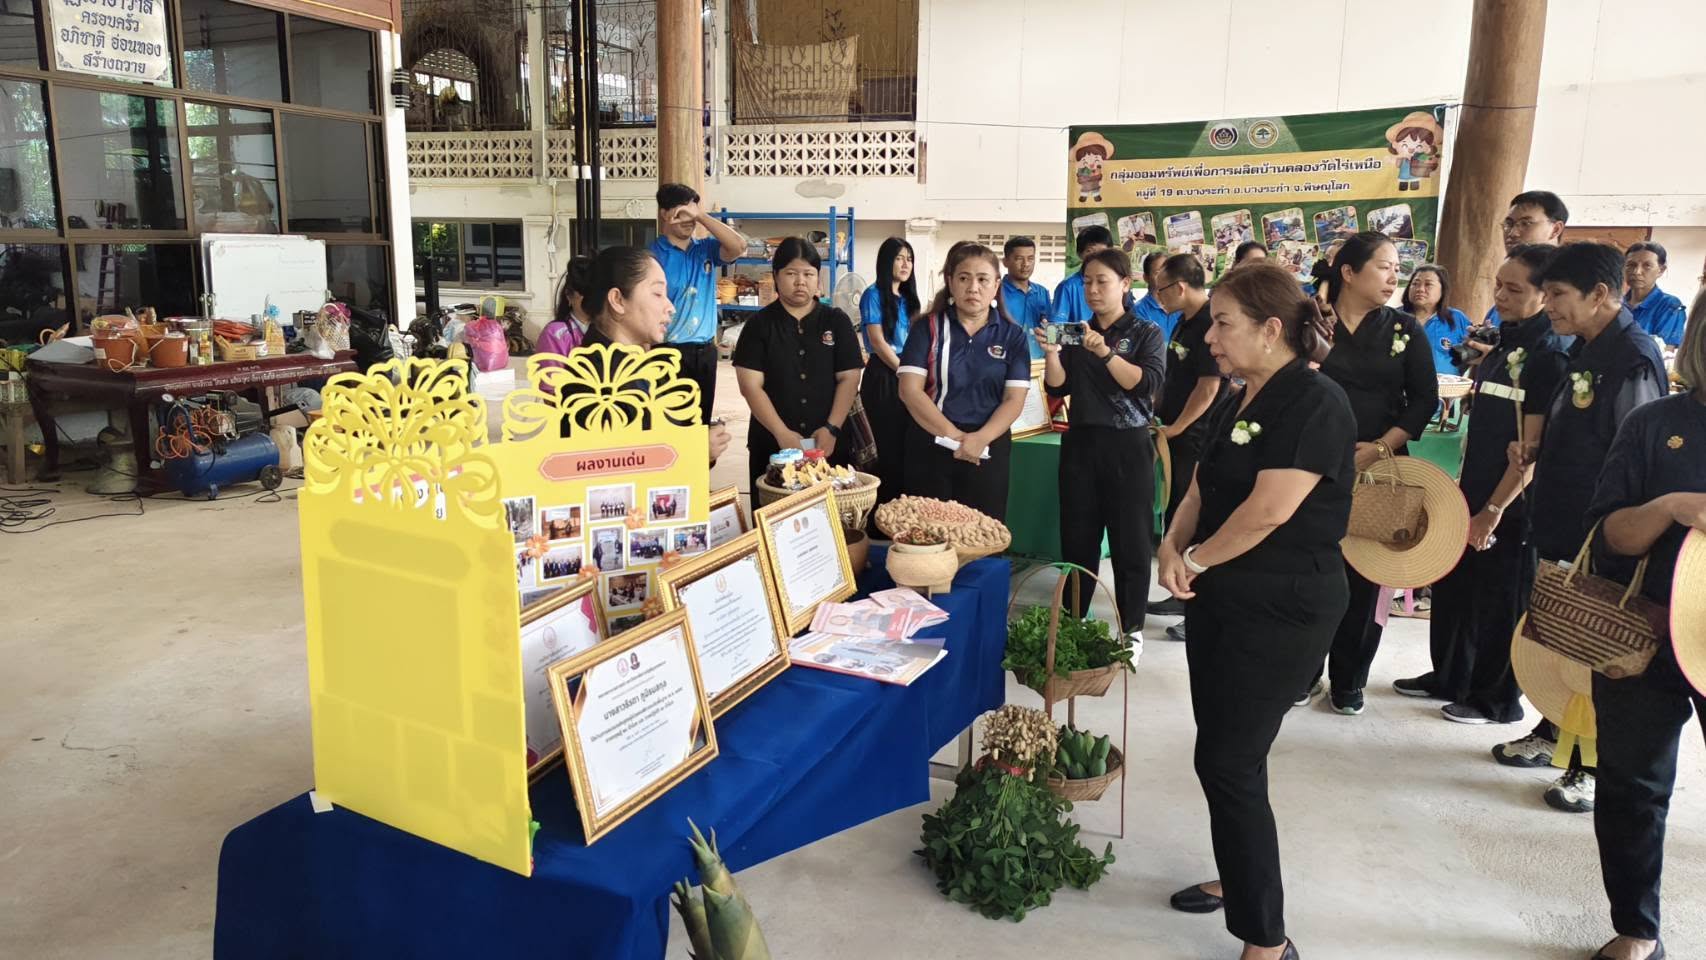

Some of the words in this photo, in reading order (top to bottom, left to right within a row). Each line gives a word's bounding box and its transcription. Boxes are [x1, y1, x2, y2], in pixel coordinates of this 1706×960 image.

[81, 10, 140, 32] ครอบครัว
[61, 26, 105, 48] อภิชาติ
[111, 34, 161, 56] อ่อนทอง
[83, 51, 146, 74] สร้างถวาย
[1110, 157, 1382, 183] กลุ่มออมทรัพย์เพื่อการผลิตบ้านคลองวัดไร่เหนือ
[1136, 185, 1156, 200] หมู่ที่
[1160, 188, 1173, 197] 19
[1176, 185, 1230, 197] ต.บางระกำ
[1234, 182, 1290, 195] อ.บางระกำ
[1294, 179, 1350, 194] จ.พิษณุโลก
[576, 451, 645, 471] ผลงานเด่น
